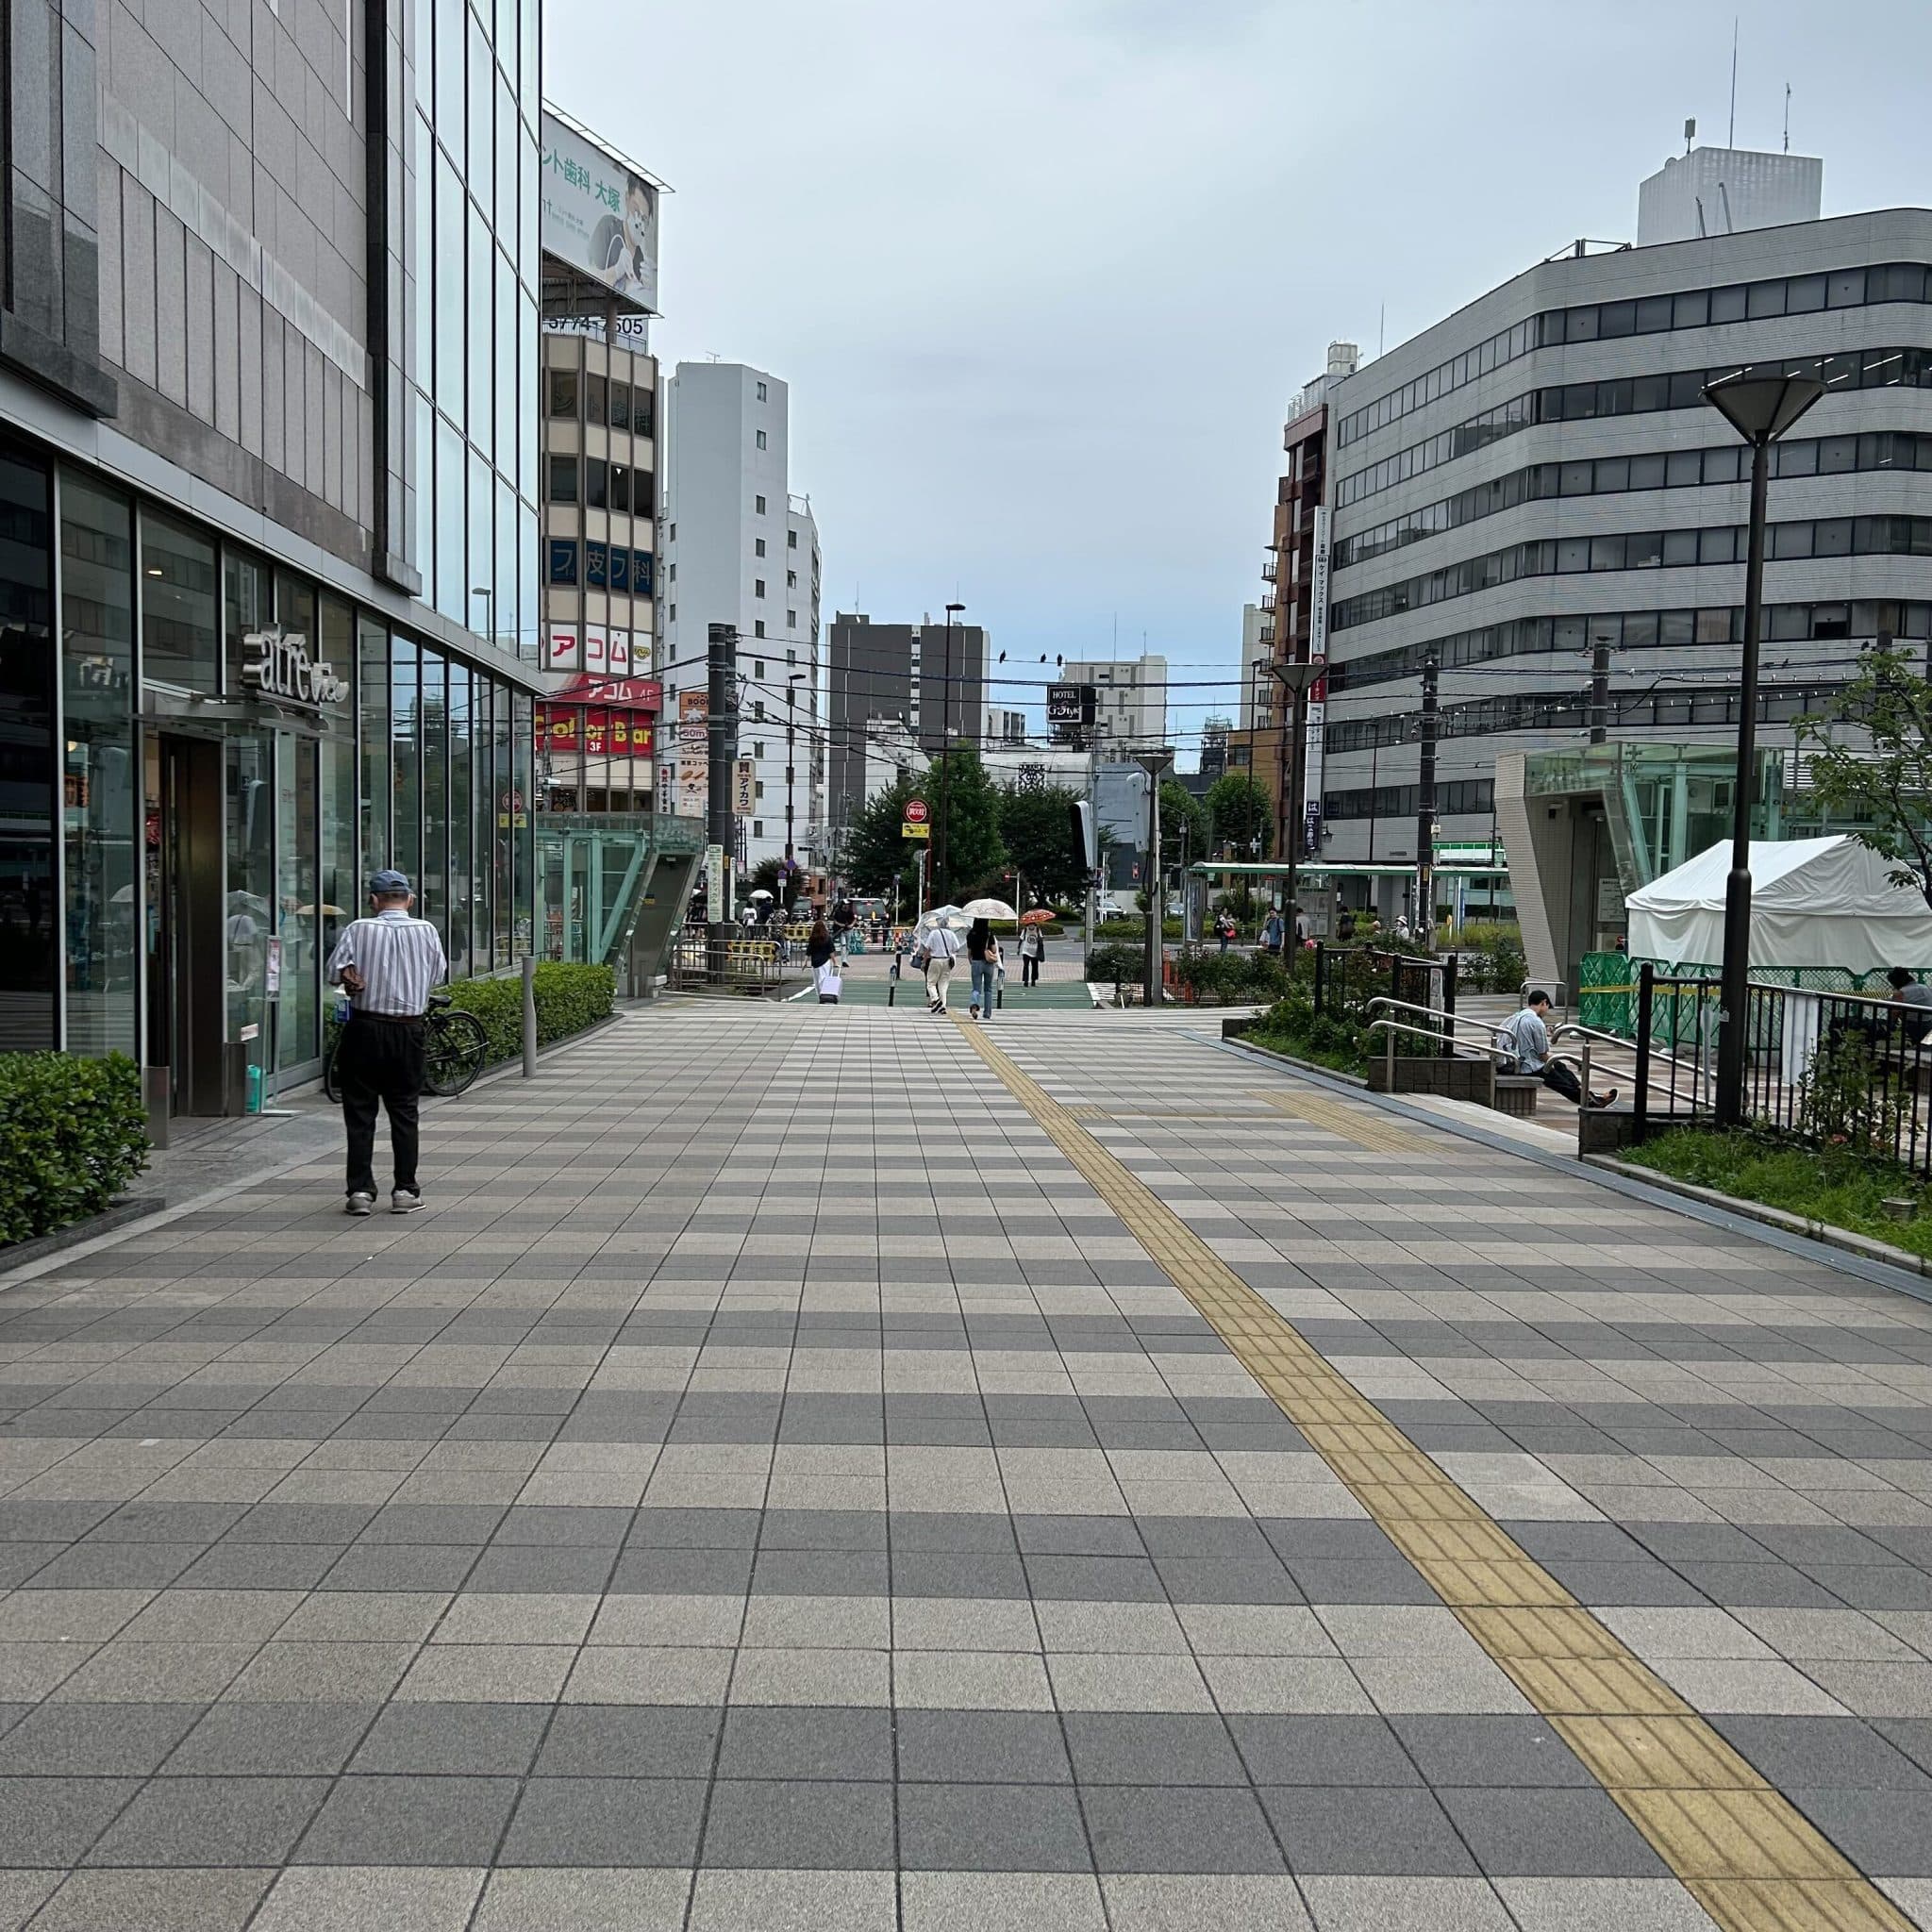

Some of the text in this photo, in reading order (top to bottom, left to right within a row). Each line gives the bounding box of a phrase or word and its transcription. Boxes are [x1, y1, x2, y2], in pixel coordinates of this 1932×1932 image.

[552, 635, 626, 662] アコム
[588, 678, 632, 701] アコム
[1053, 691, 1075, 699] HOTEL
[614, 721, 651, 744] Bar
[590, 741, 601, 751] 3F
